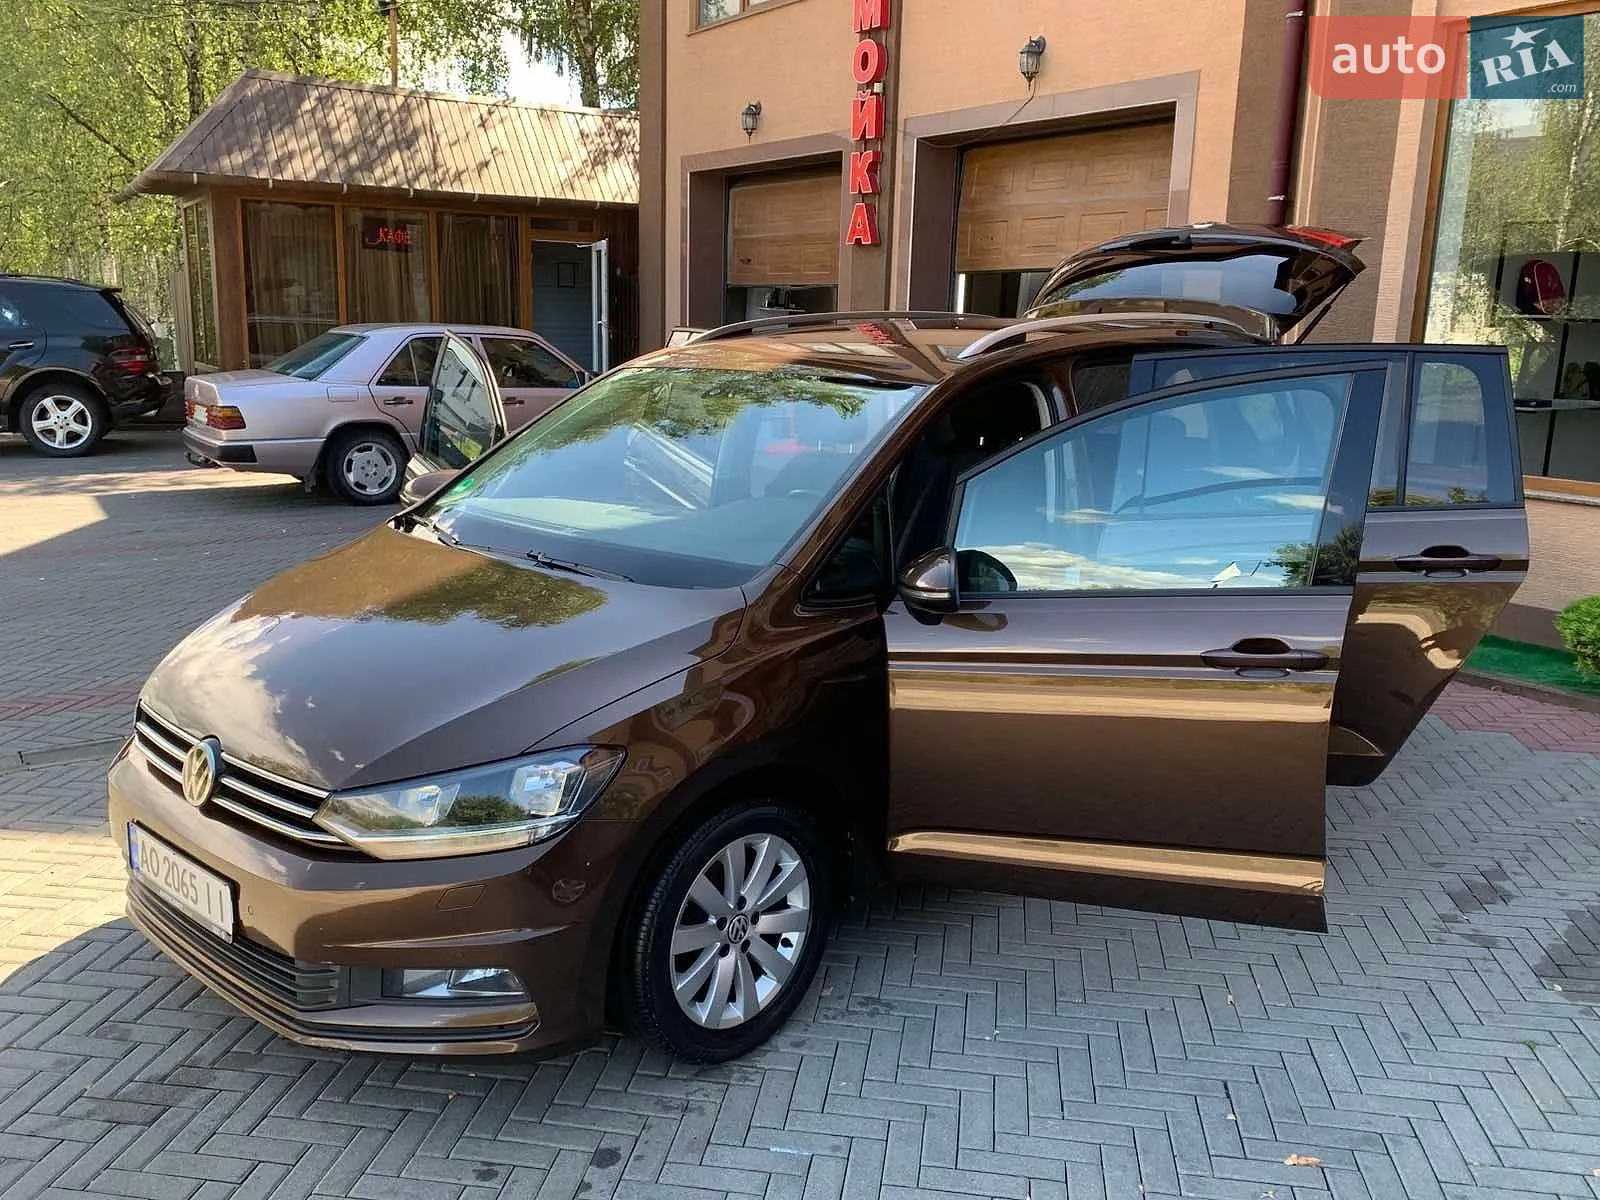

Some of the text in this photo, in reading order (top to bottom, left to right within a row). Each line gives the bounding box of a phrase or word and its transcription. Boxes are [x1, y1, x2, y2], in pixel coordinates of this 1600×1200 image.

[846, 0, 888, 244] МОЙКА
[140, 839, 160, 878] AO
[162, 855, 199, 905] 2065
